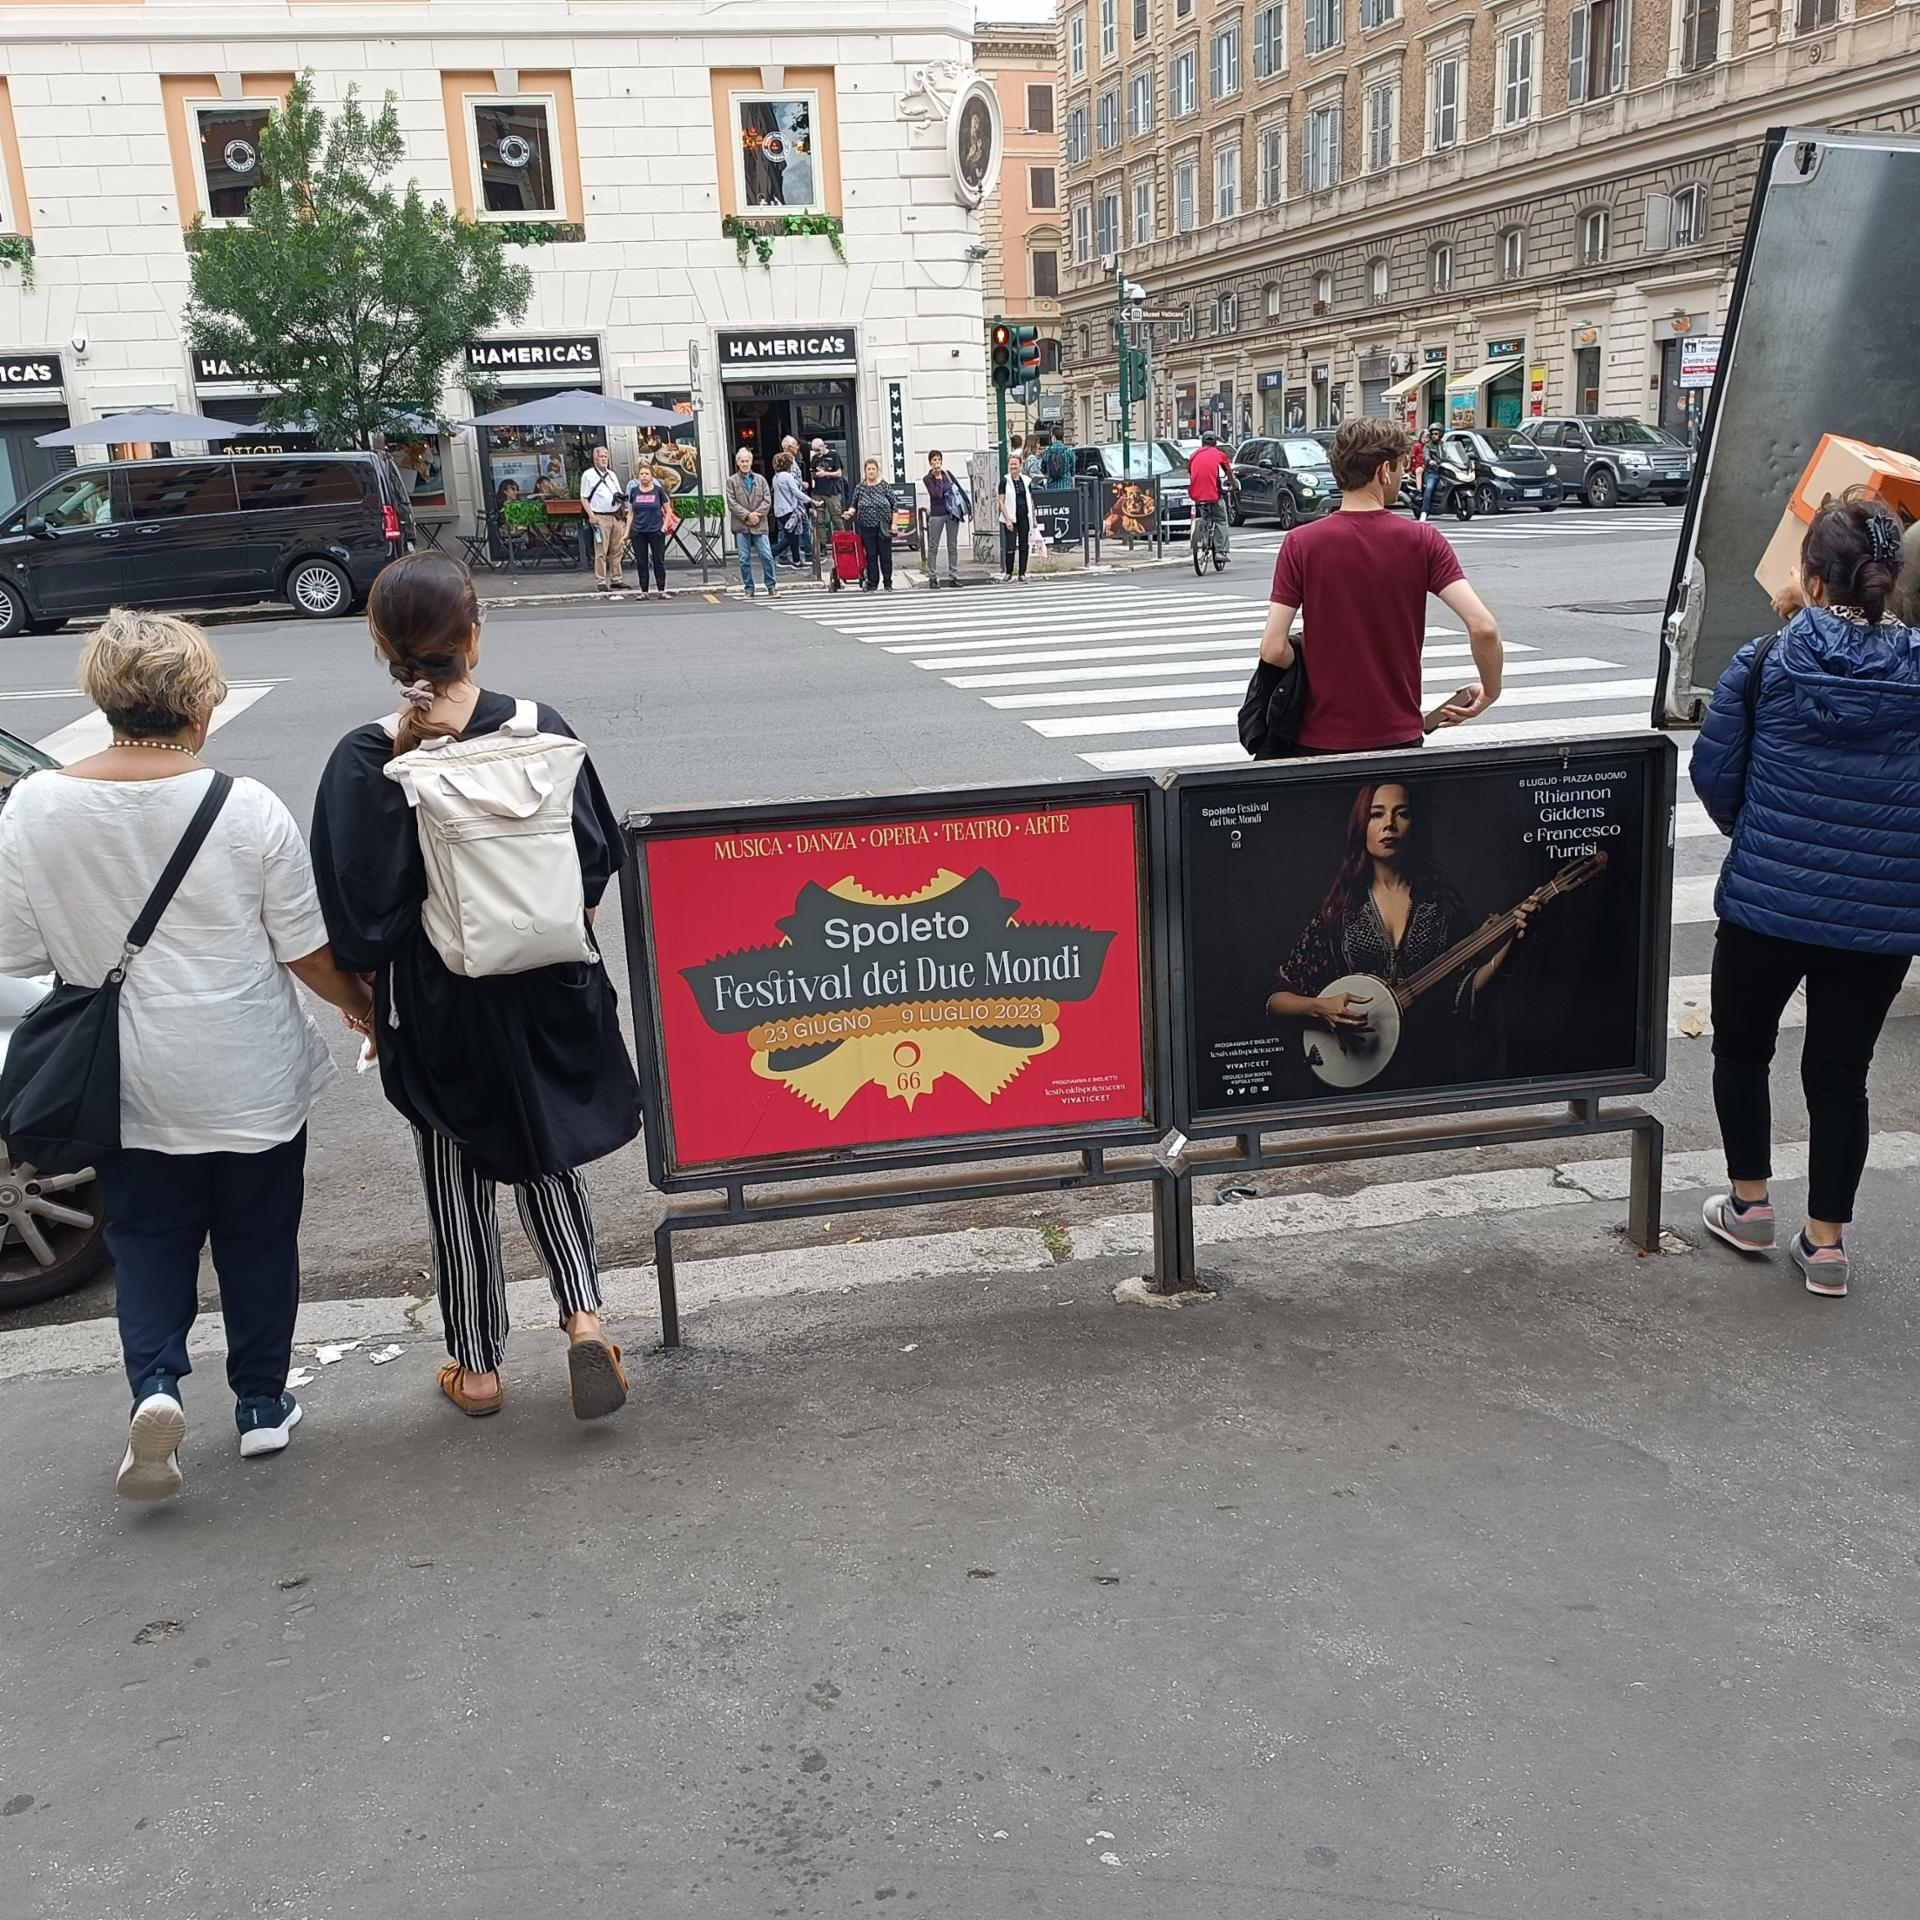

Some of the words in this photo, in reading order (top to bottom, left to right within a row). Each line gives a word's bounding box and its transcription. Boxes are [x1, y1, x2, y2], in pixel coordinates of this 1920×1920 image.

[471, 344, 593, 364] HAMERICA'S
[729, 335, 846, 357] HAMERICA'S
[1266, 374, 1278, 386] TIM
[1316, 367, 1328, 380] TIM
[1519, 779, 1525, 787] 6
[1526, 776, 1558, 787] LUGLIO
[1563, 774, 1594, 784] PIAZZA
[1594, 771, 1627, 781] DUOMO
[1534, 787, 1612, 805] Rhiannon
[1202, 806, 1236, 817] Spoleto
[1237, 801, 1269, 814] Festival
[1540, 806, 1605, 823] Giddens
[1209, 816, 1222, 827] dei
[1222, 816, 1238, 826] Due
[1238, 813, 1262, 824] Mondi
[714, 837, 784, 861] MUSICA
[796, 831, 858, 855] DANZA
[869, 825, 931, 848] OPERA
[941, 818, 1012, 843] TEATRO
[1024, 814, 1071, 836] ARTE
[1523, 831, 1534, 843] e
[1537, 824, 1621, 842] Francesco
[1545, 841, 1598, 859] Turrisi
[824, 911, 970, 953] Spoleto
[713, 964, 852, 1012] Festival
[862, 960, 909, 997] dei
[916, 955, 976, 993] Due
[984, 945, 1082, 987] Mondi
[764, 1027, 789, 1044] 23
[793, 1013, 872, 1040] GIUGNO
[901, 1008, 915, 1025] 9
[919, 1004, 989, 1024] LUGLIO
[994, 1003, 1042, 1021] 2023
[1226, 1060, 1270, 1069] VIVATICKET
[896, 1071, 922, 1091] 66
[1061, 1094, 1111, 1104] VIVATICKET
